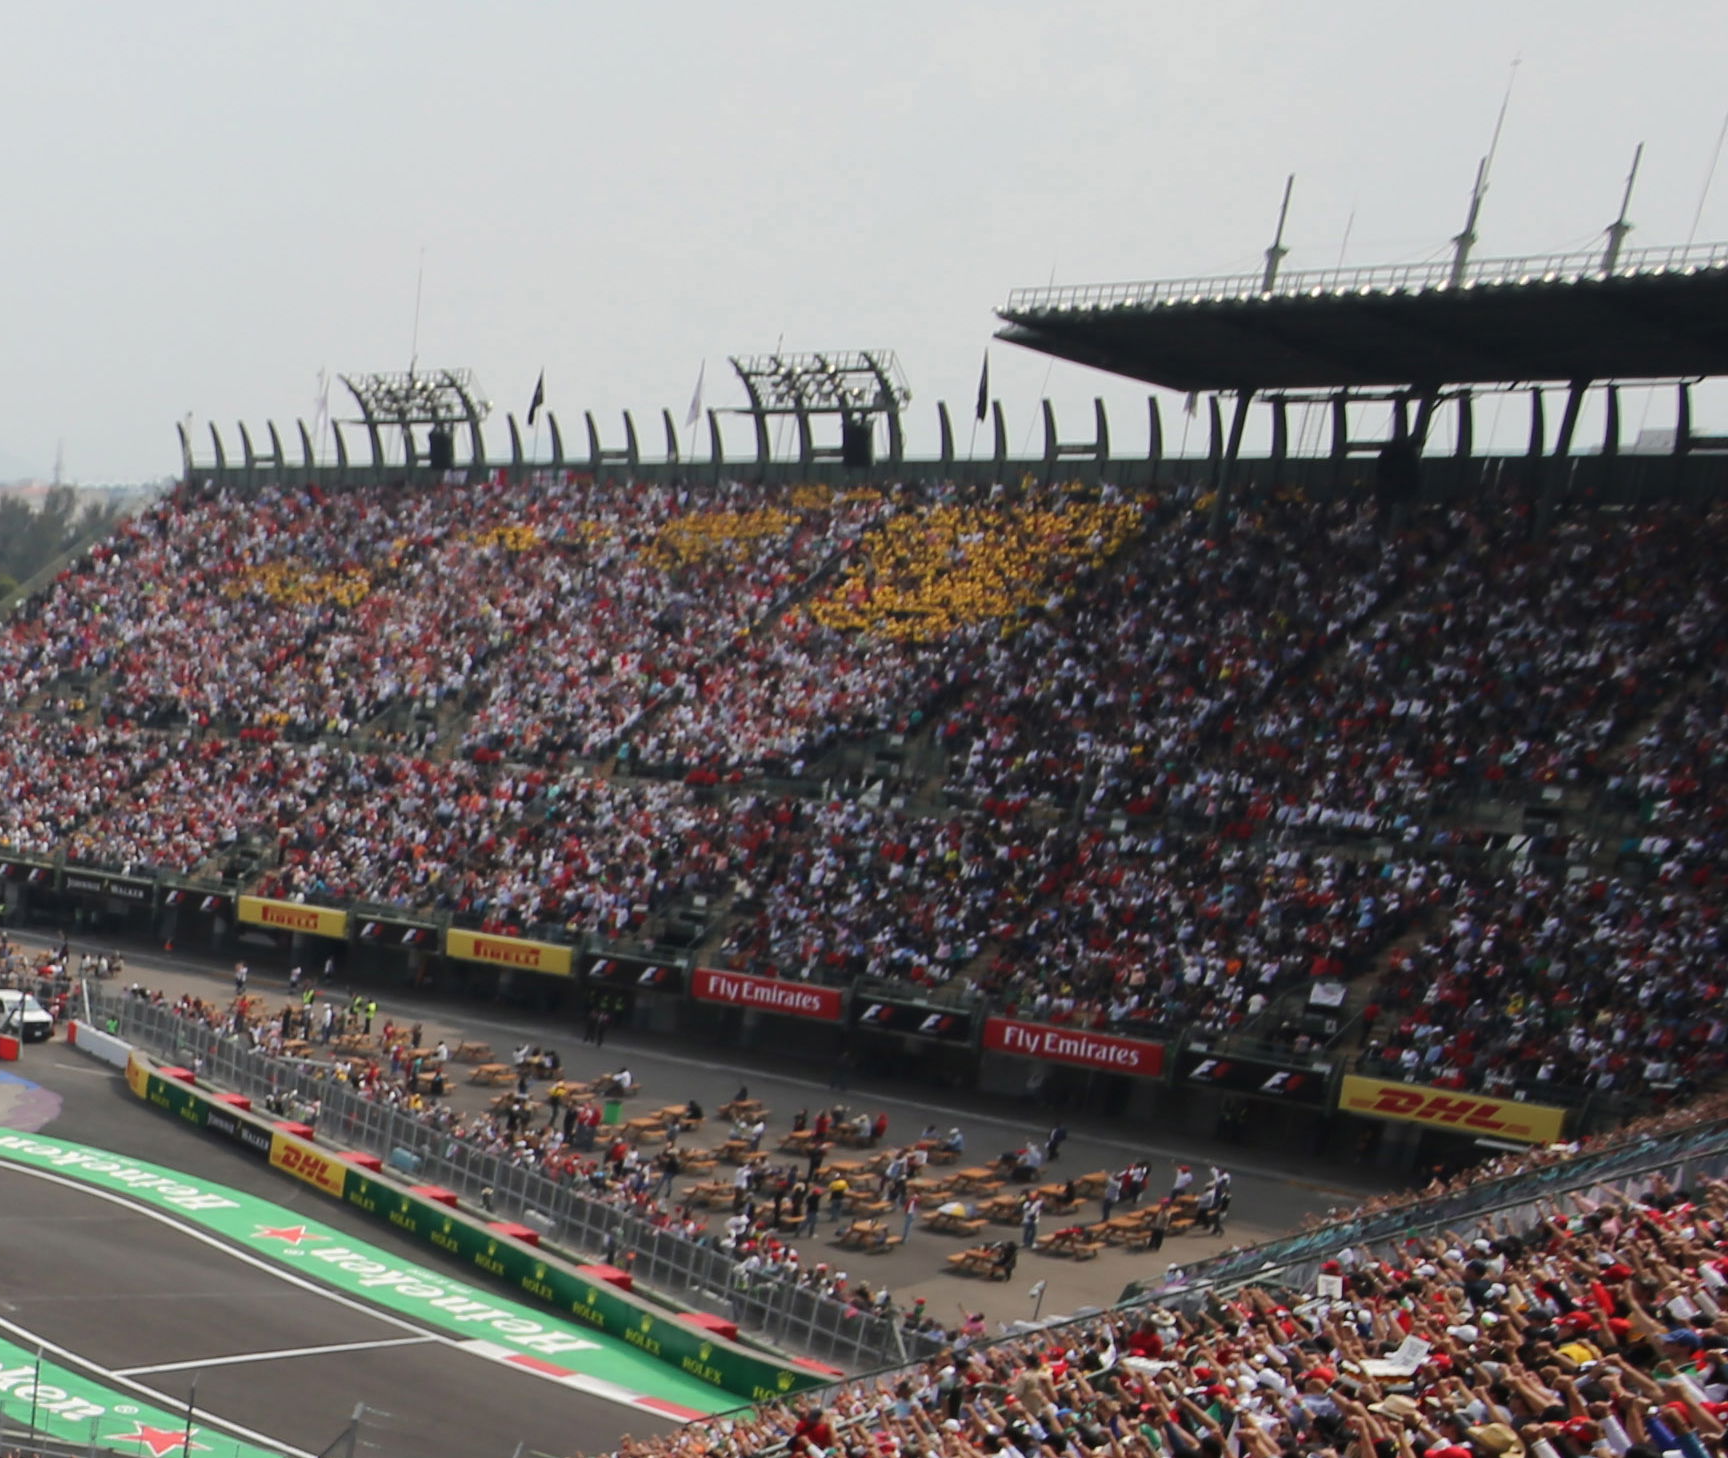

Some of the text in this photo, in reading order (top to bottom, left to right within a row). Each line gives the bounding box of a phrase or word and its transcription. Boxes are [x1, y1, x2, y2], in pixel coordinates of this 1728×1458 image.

[262, 906, 319, 930] PIRELLI
[473, 940, 541, 967] PIRELLI
[708, 975, 820, 1011] Fly Emirates
[1003, 1025, 1139, 1066] Fly Emirates
[1372, 1088, 1507, 1130] DHL
[281, 1145, 331, 1187] DHL
[431, 1229, 458, 1252] ROLEX
[474, 1251, 505, 1276] ROLEX
[310, 1246, 604, 1354] Heineken
[522, 1276, 553, 1300] ROLEX
[572, 1301, 605, 1326] ROLEX
[625, 1327, 661, 1356] ROLEX
[682, 1356, 723, 1385] ROLEX
